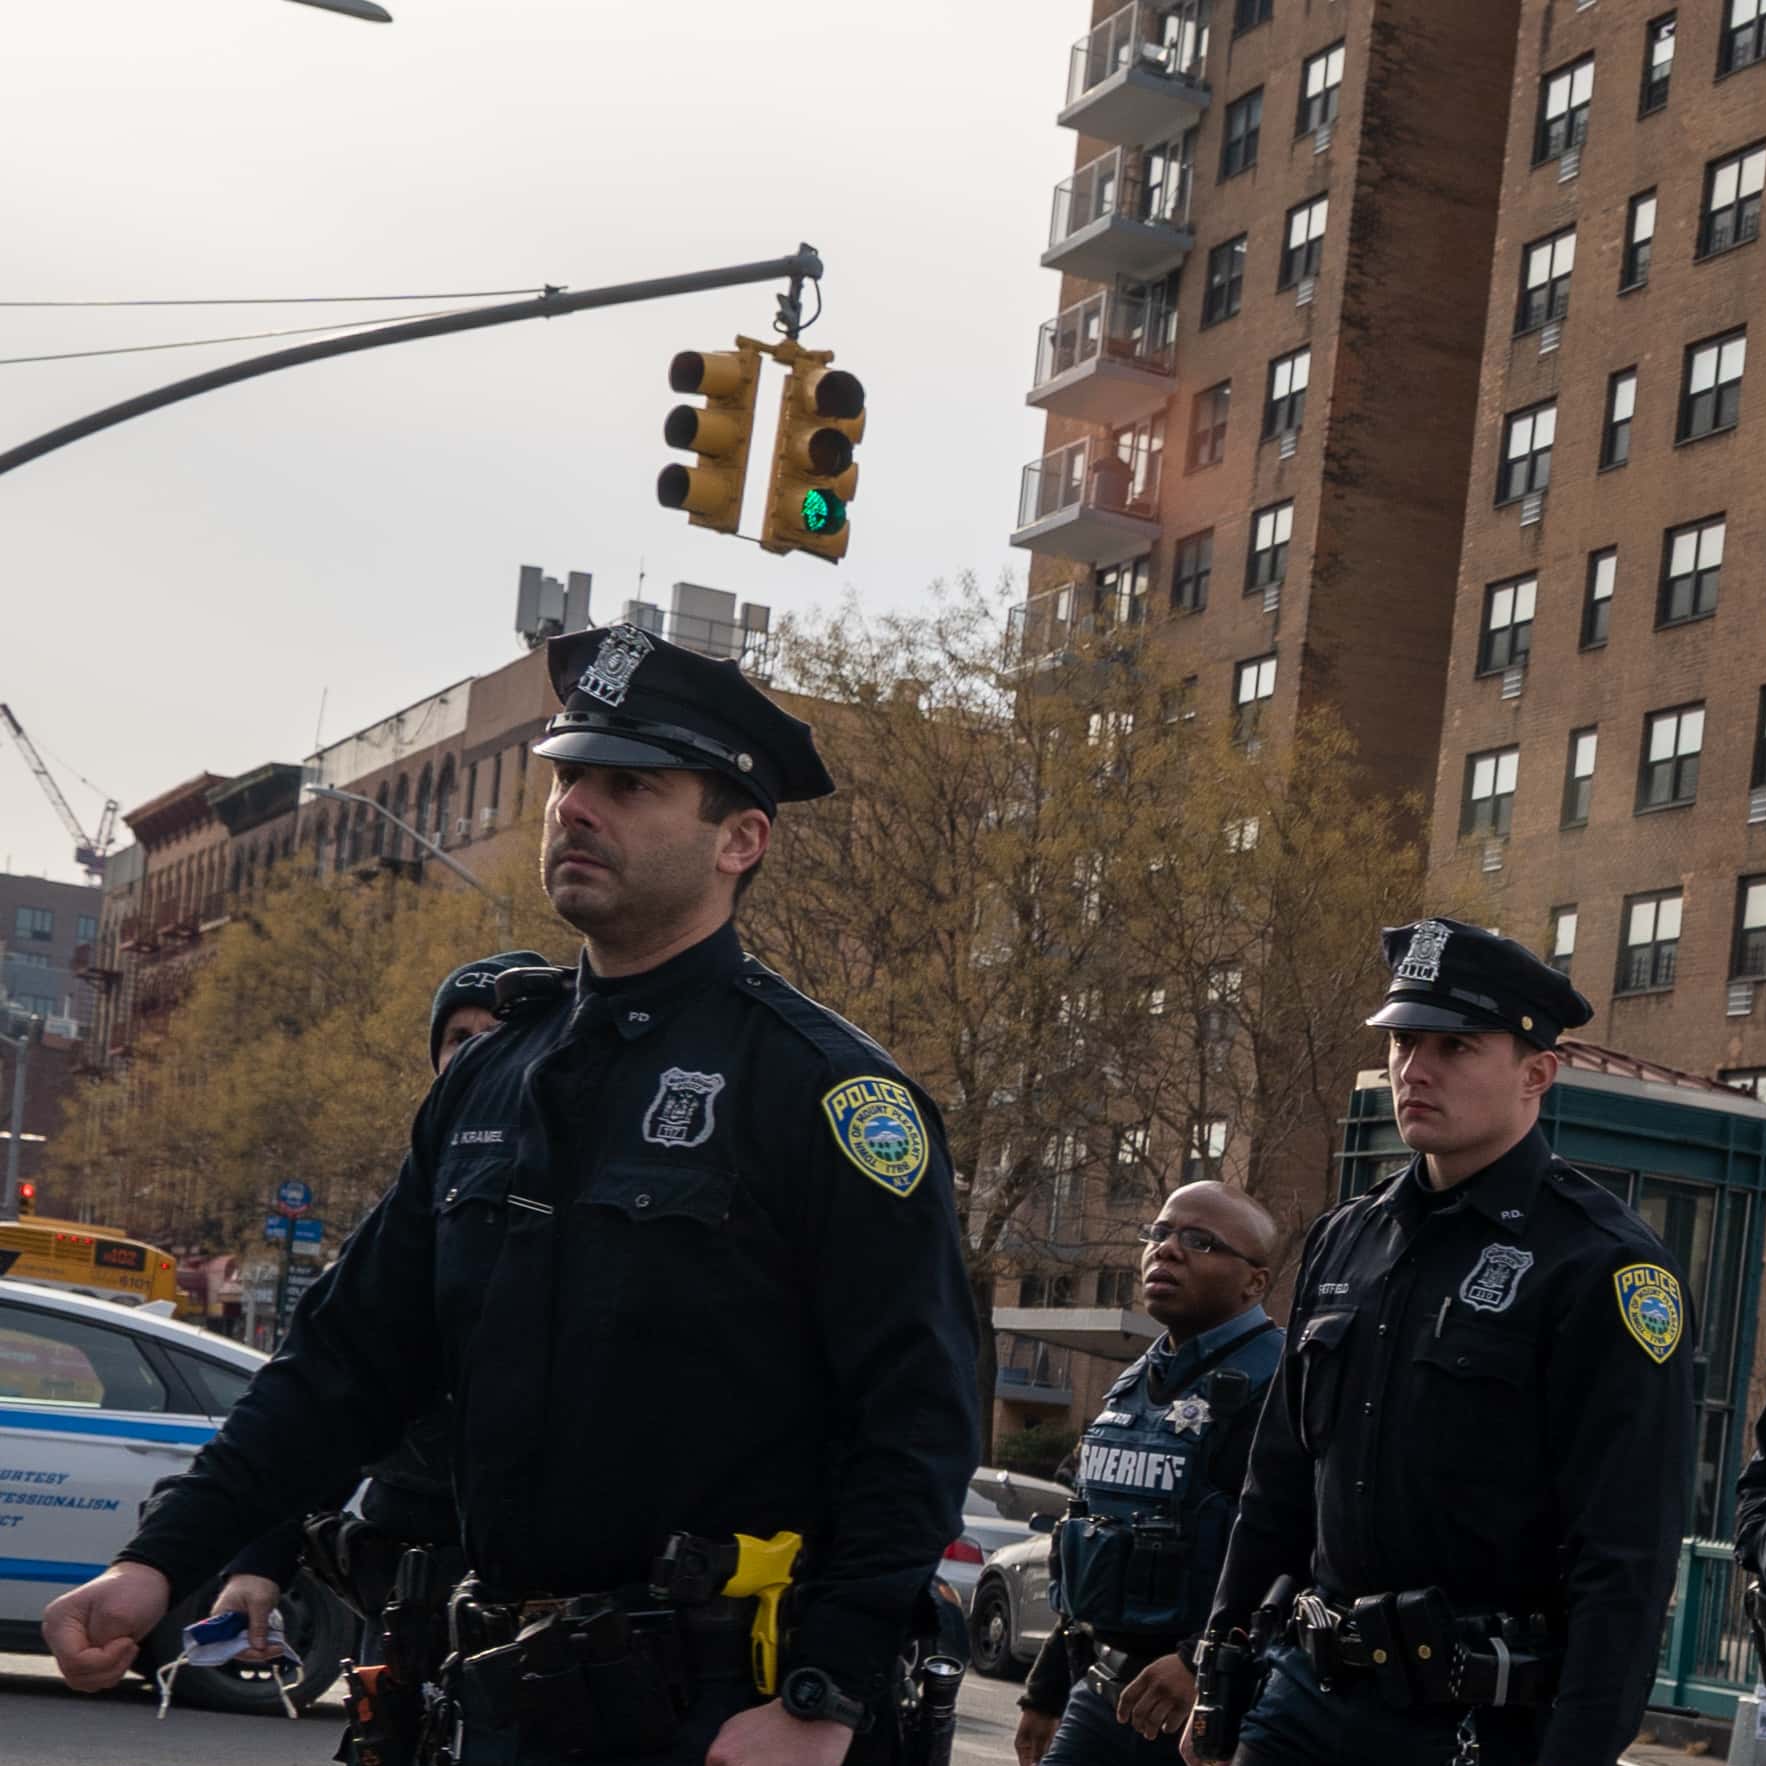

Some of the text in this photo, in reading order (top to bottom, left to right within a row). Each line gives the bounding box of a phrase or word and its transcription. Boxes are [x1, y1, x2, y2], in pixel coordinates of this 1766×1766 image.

[831, 1082, 912, 1120] POLICE
[1622, 1269, 1679, 1299] POLICE
[1080, 1444, 1186, 1491] SHERIFF
